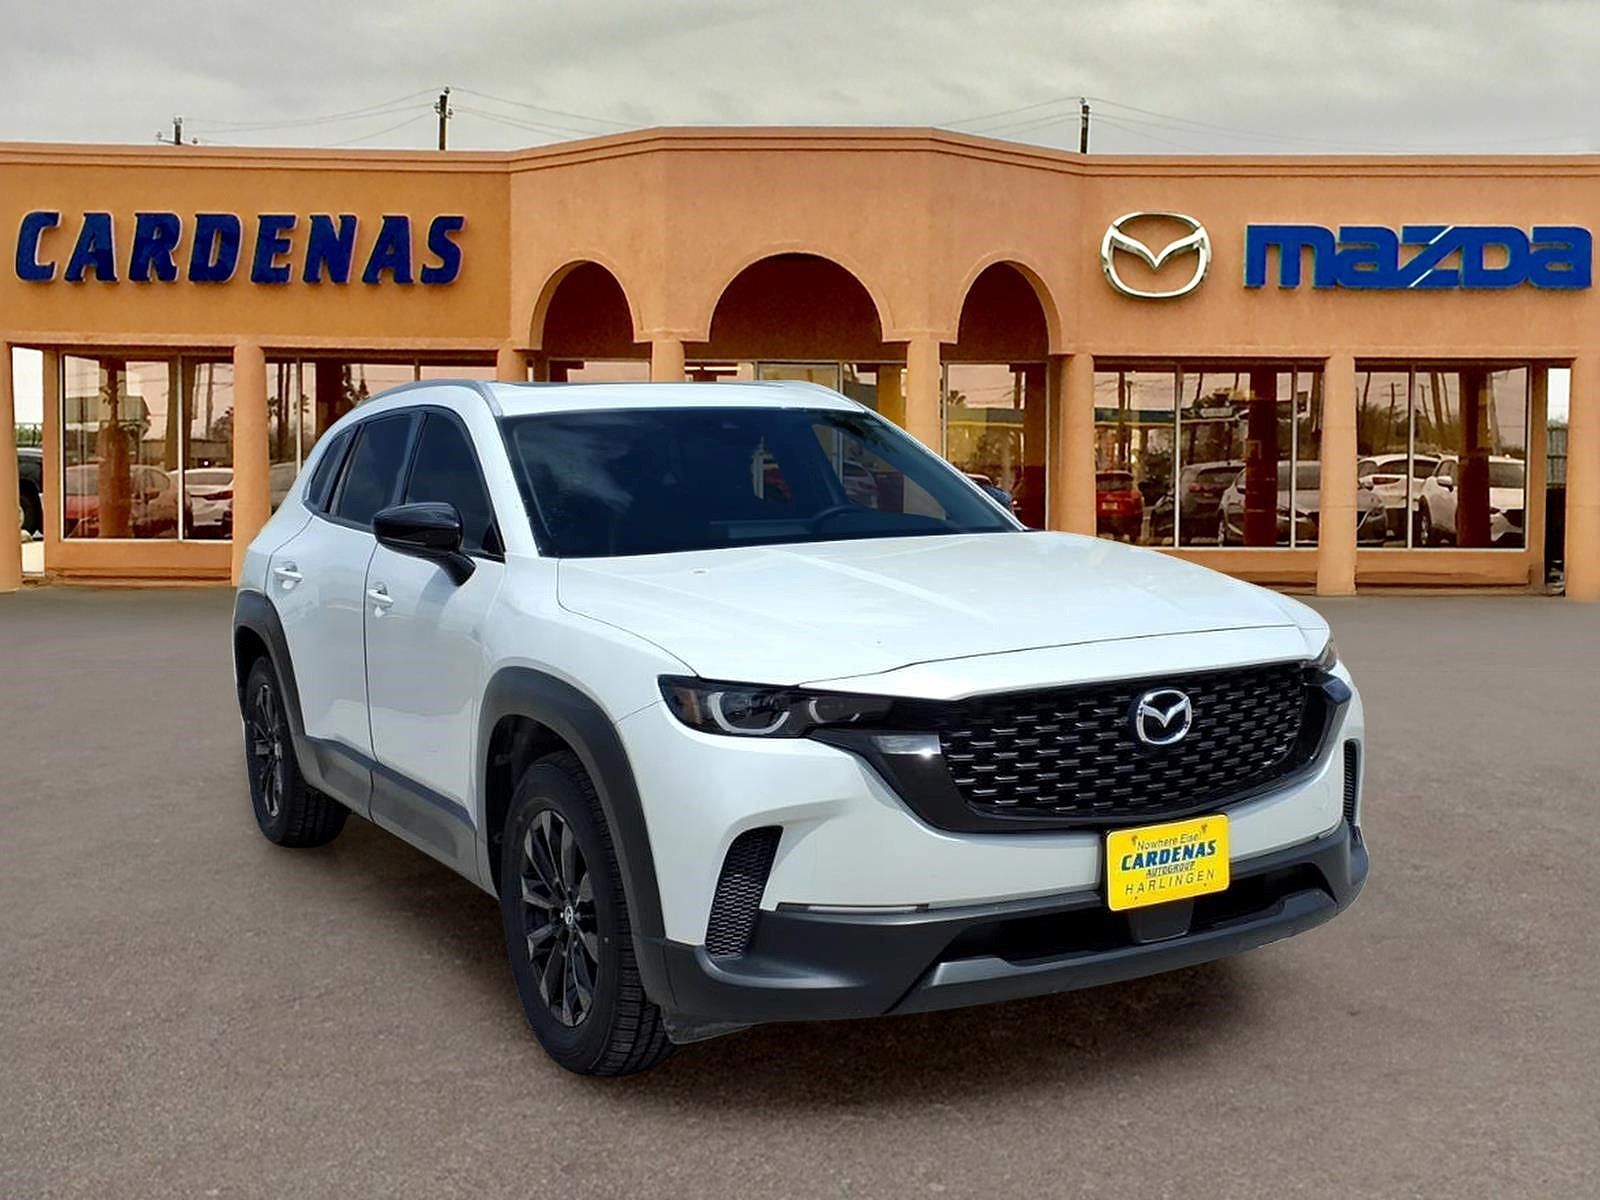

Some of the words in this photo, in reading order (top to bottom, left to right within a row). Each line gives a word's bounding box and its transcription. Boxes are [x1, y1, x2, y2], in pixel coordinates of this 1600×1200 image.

[15, 210, 466, 285] CARDENAS
[1121, 840, 1217, 871] CARDENAS
[1137, 837, 1178, 850] Nowhere
[1125, 869, 1215, 895] HARLINGEN
